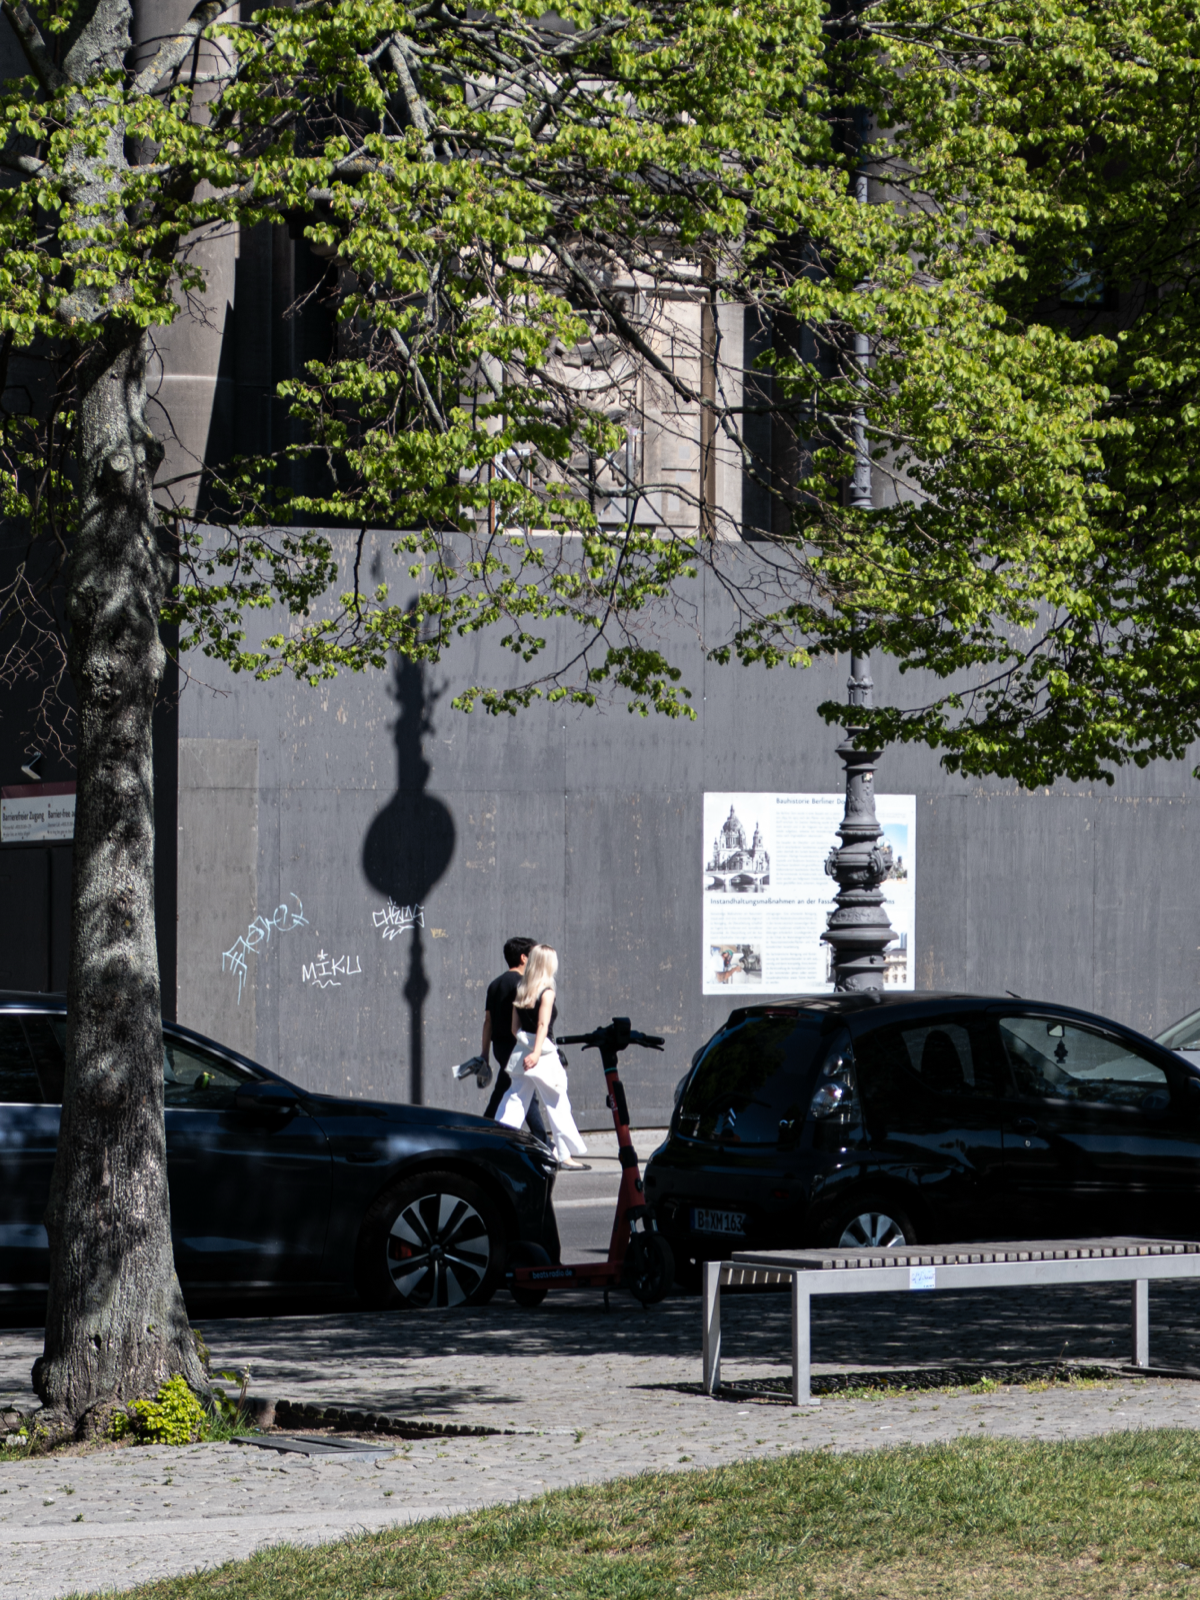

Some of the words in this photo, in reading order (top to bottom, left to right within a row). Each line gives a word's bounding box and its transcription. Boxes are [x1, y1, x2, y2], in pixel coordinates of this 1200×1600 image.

[776, 797, 810, 805] Bauhistorie
[811, 797, 835, 805] Berliner
[29, 811, 45, 823] Zugang
[48, 808, 71, 819] Barrier-free
[710, 897, 796, 907] Instandhaltungsmaßnahmen
[806, 897, 816, 905] der
[302, 949, 362, 983] MIKU
